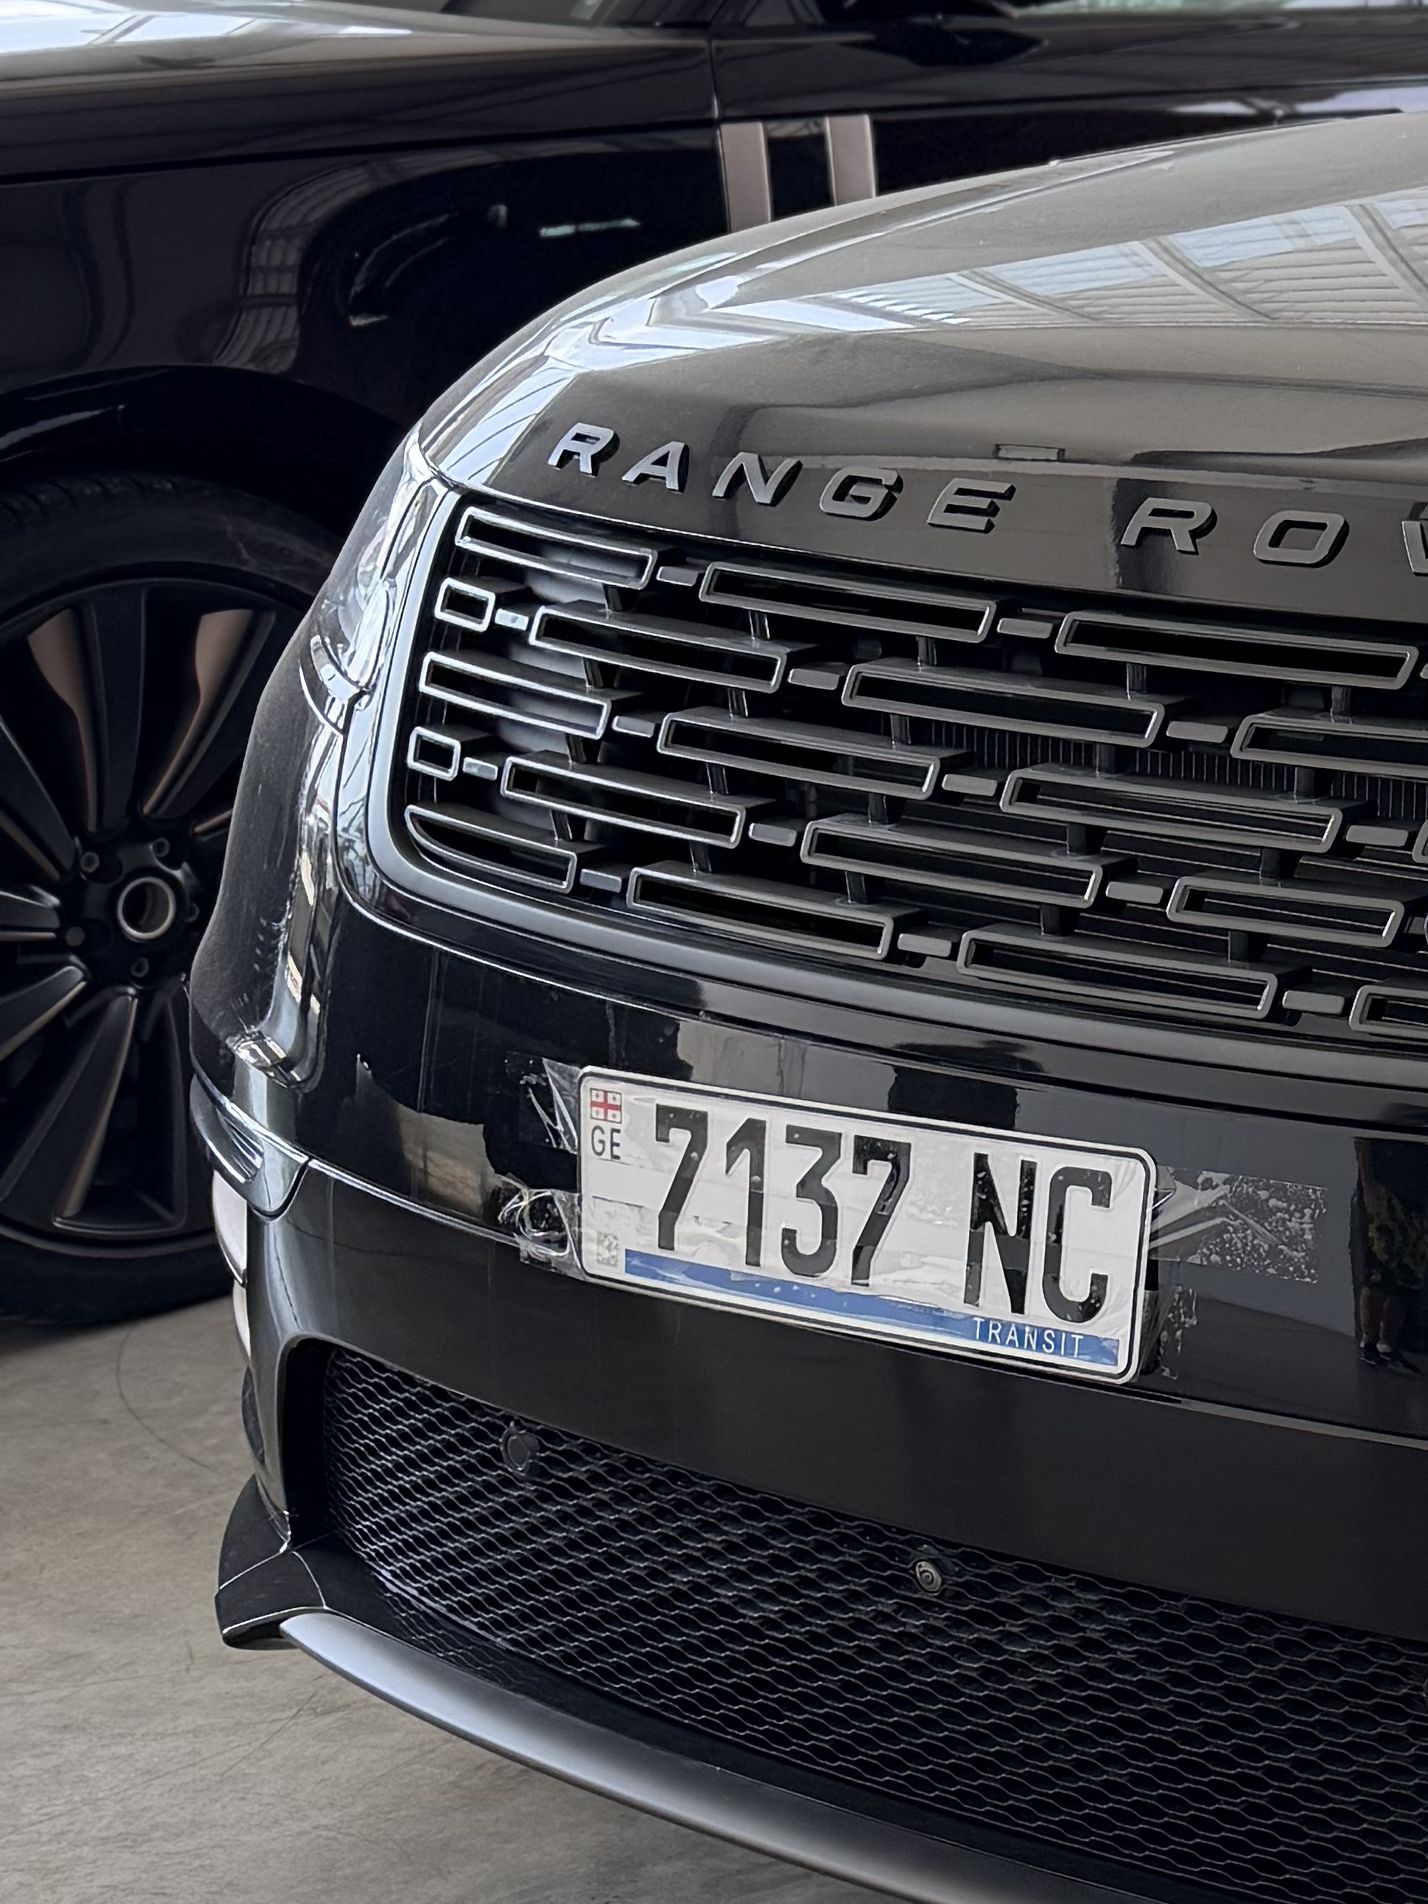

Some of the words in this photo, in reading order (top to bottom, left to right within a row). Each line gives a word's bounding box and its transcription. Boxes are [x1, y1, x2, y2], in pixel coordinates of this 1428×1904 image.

[547, 422, 1016, 534] RANGE
[591, 1125, 622, 1161] GE
[655, 1104, 912, 1287] 7137
[964, 1152, 1112, 1324] NC
[972, 1317, 1084, 1357] TRANSIT
